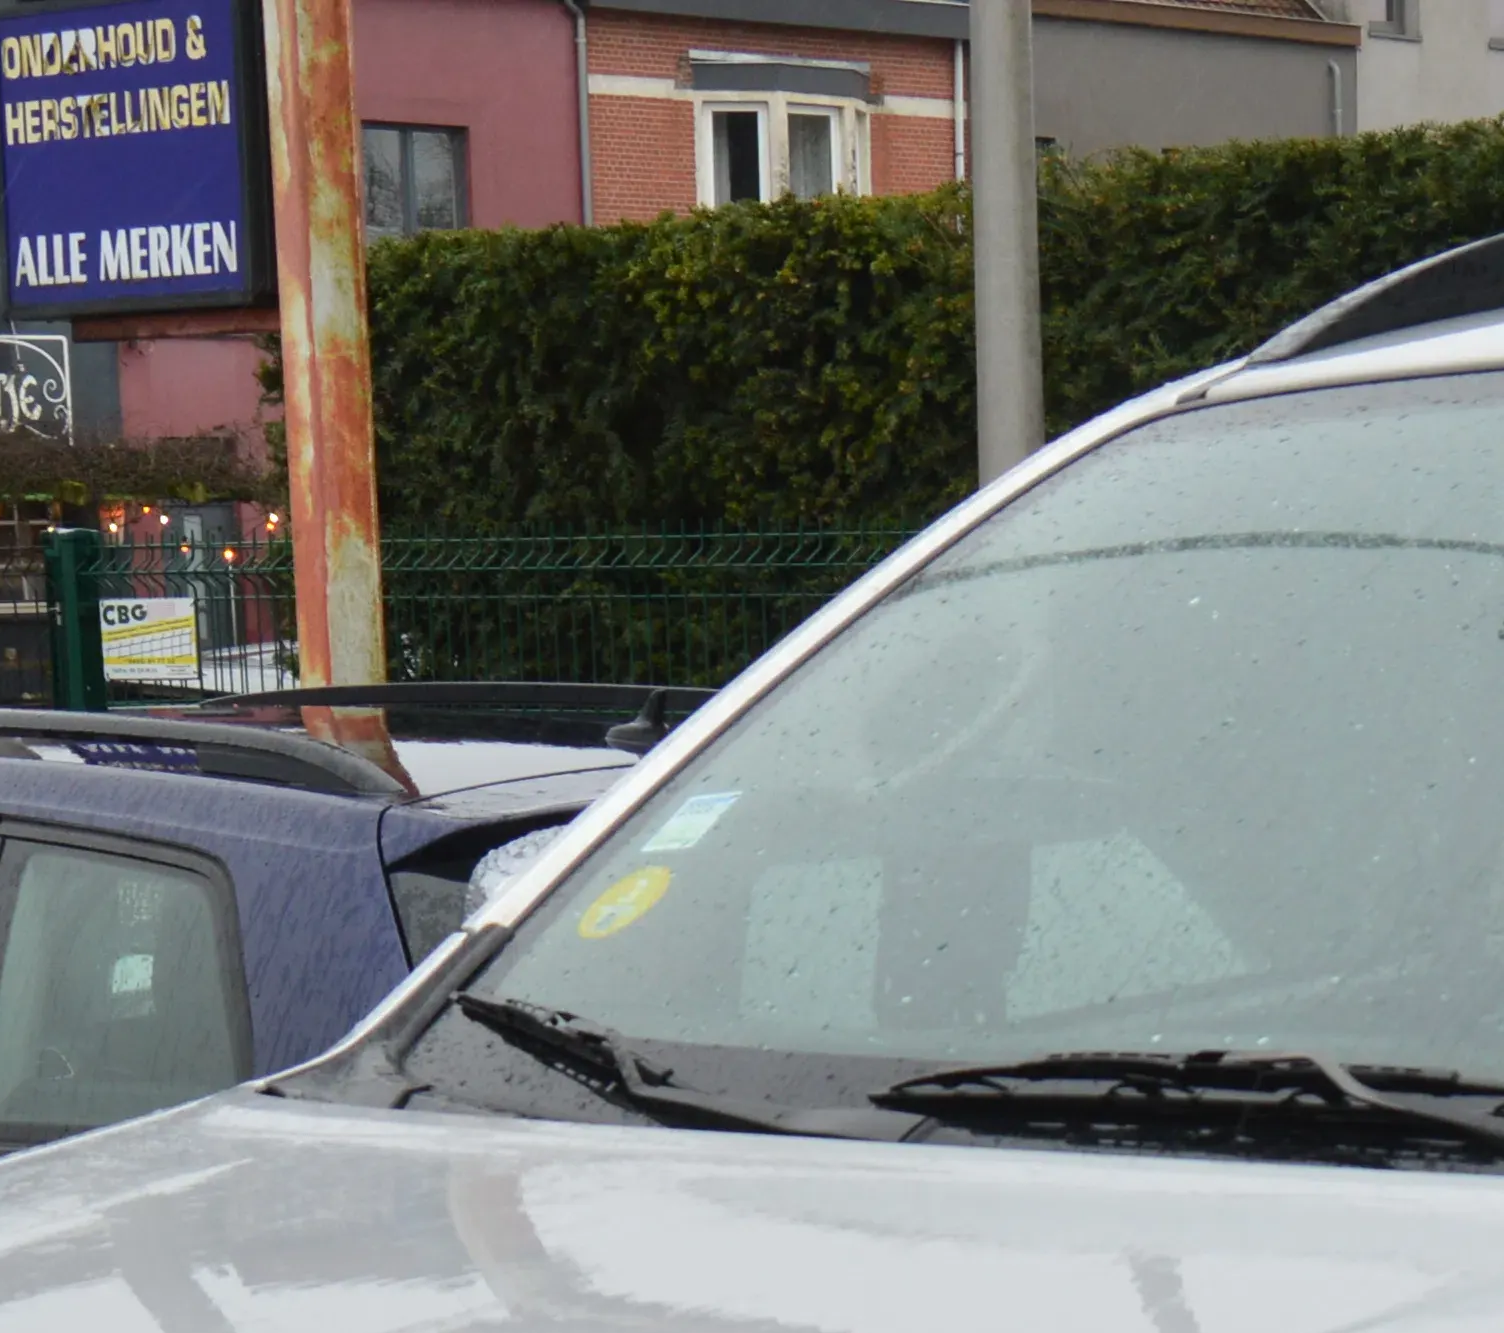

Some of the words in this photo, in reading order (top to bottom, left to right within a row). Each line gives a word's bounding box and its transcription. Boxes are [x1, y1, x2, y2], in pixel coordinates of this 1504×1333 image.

[1, 18, 177, 80] ONDERHOUD
[185, 15, 207, 60] &
[4, 80, 231, 146] HERSTELLINGEN
[15, 232, 88, 287] ALLE
[99, 220, 238, 282] MERKEN
[103, 604, 147, 626] CBG
